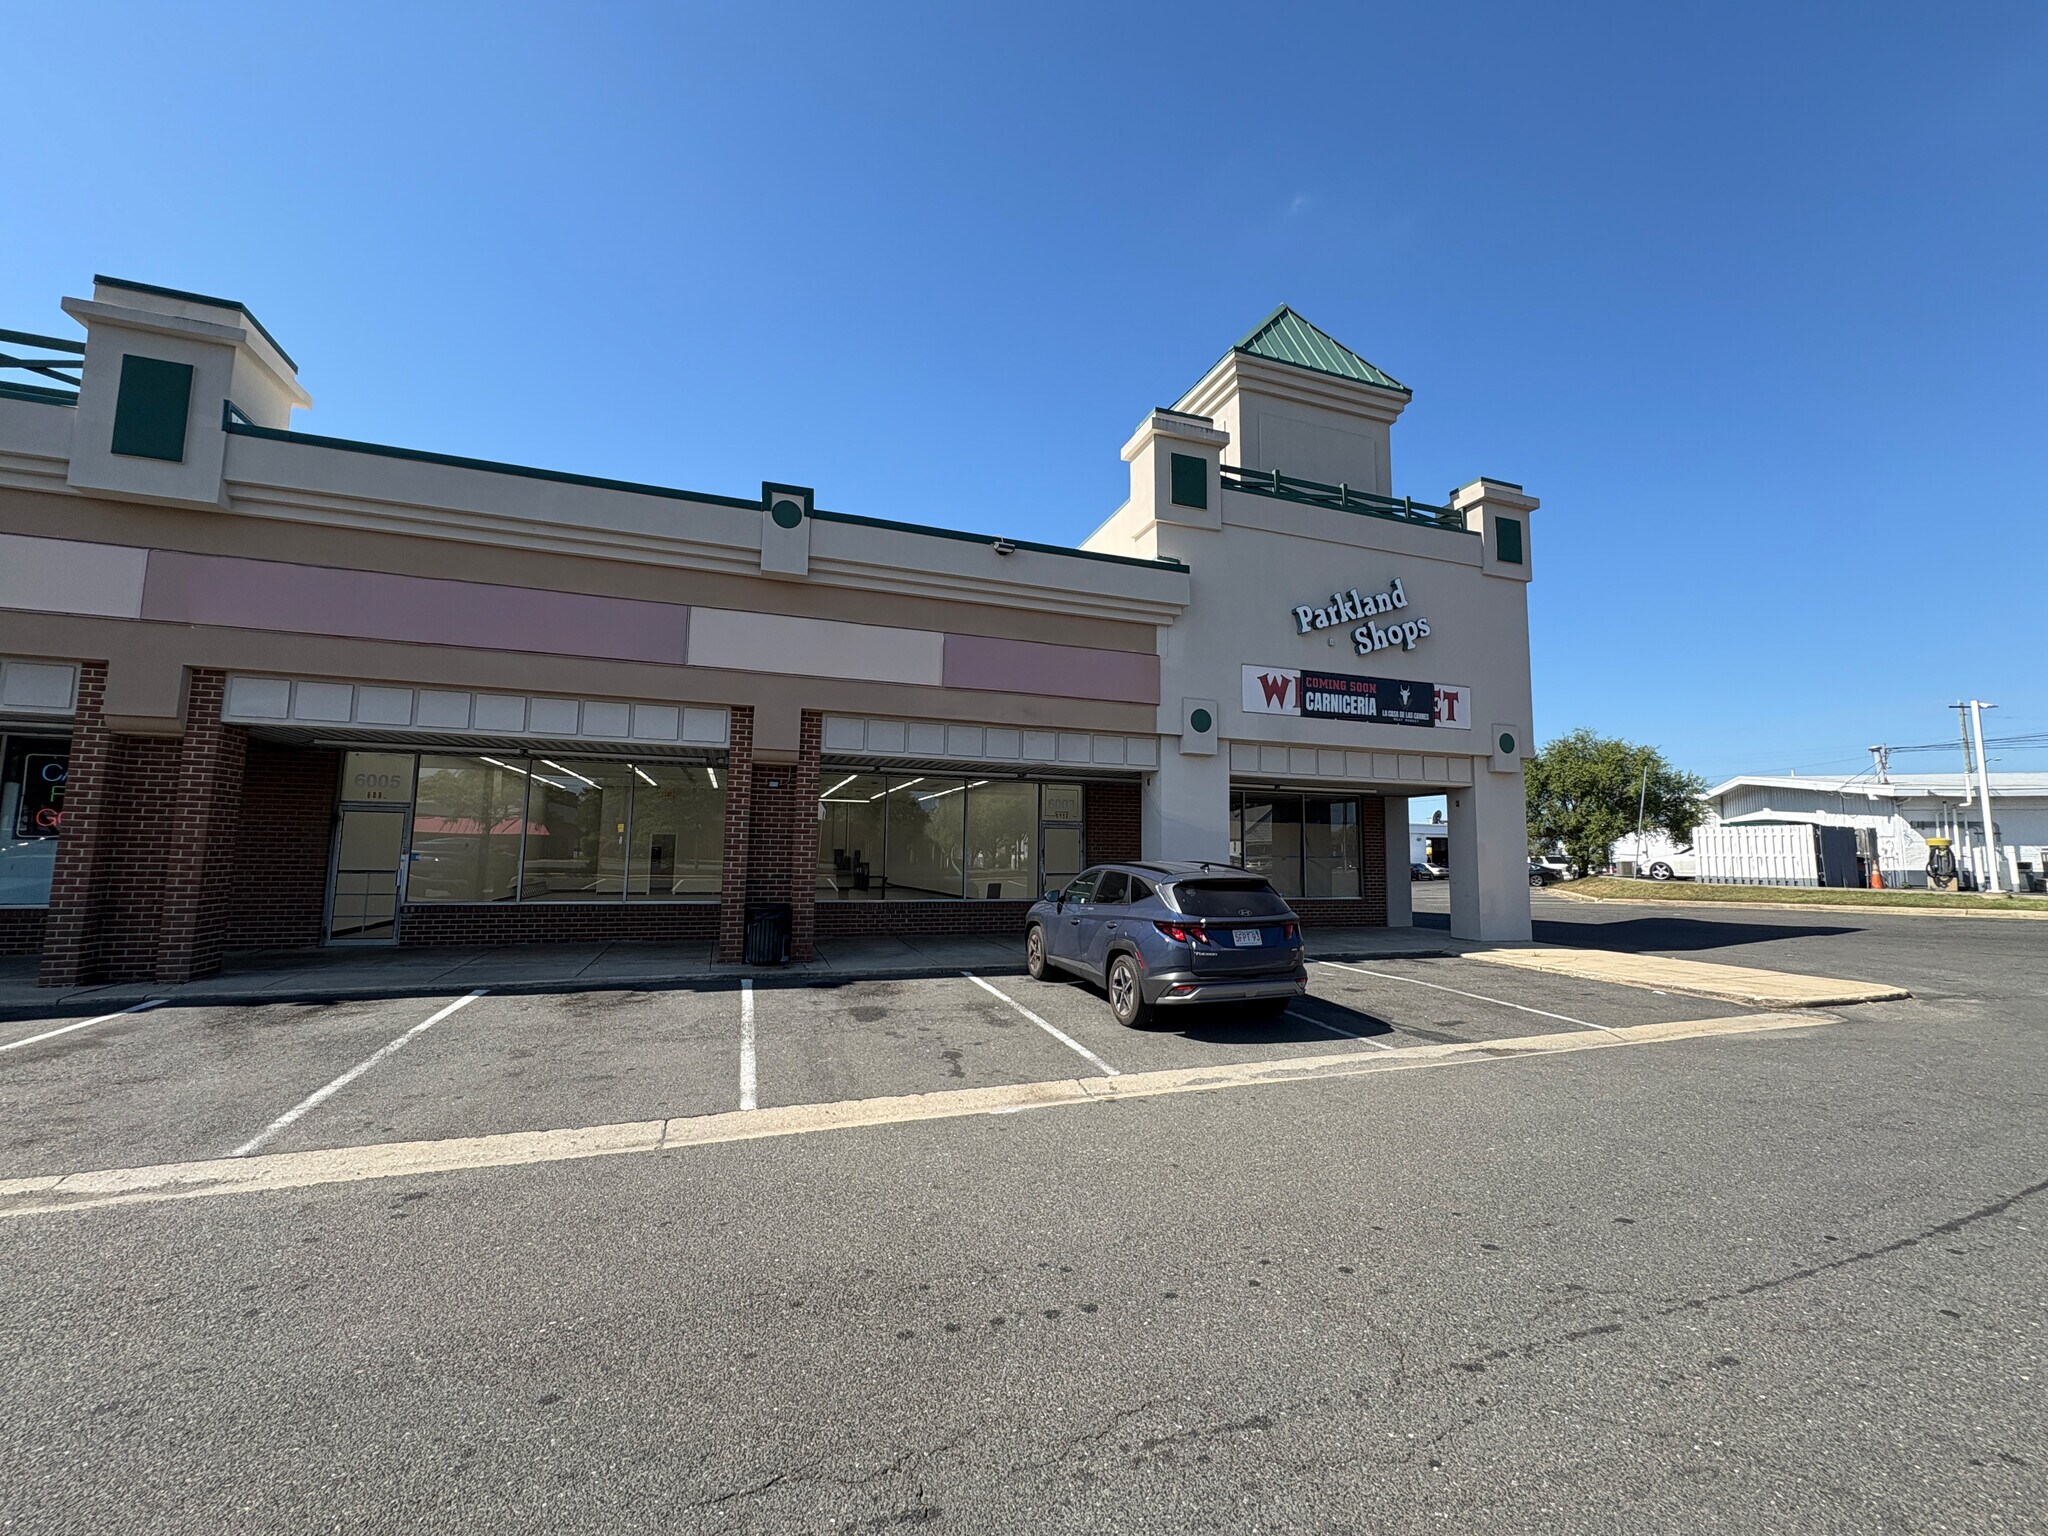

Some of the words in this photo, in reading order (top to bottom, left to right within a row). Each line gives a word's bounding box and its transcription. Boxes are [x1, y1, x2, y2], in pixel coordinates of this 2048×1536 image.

[1293, 577, 1409, 634] Parkland
[1352, 617, 1431, 655] Shops
[1305, 677, 1346, 690] COMING
[1350, 682, 1376, 694] SOON
[1306, 691, 1377, 715] CARNICERÍA
[1399, 710, 1405, 718] DE
[354, 773, 401, 788] 6005
